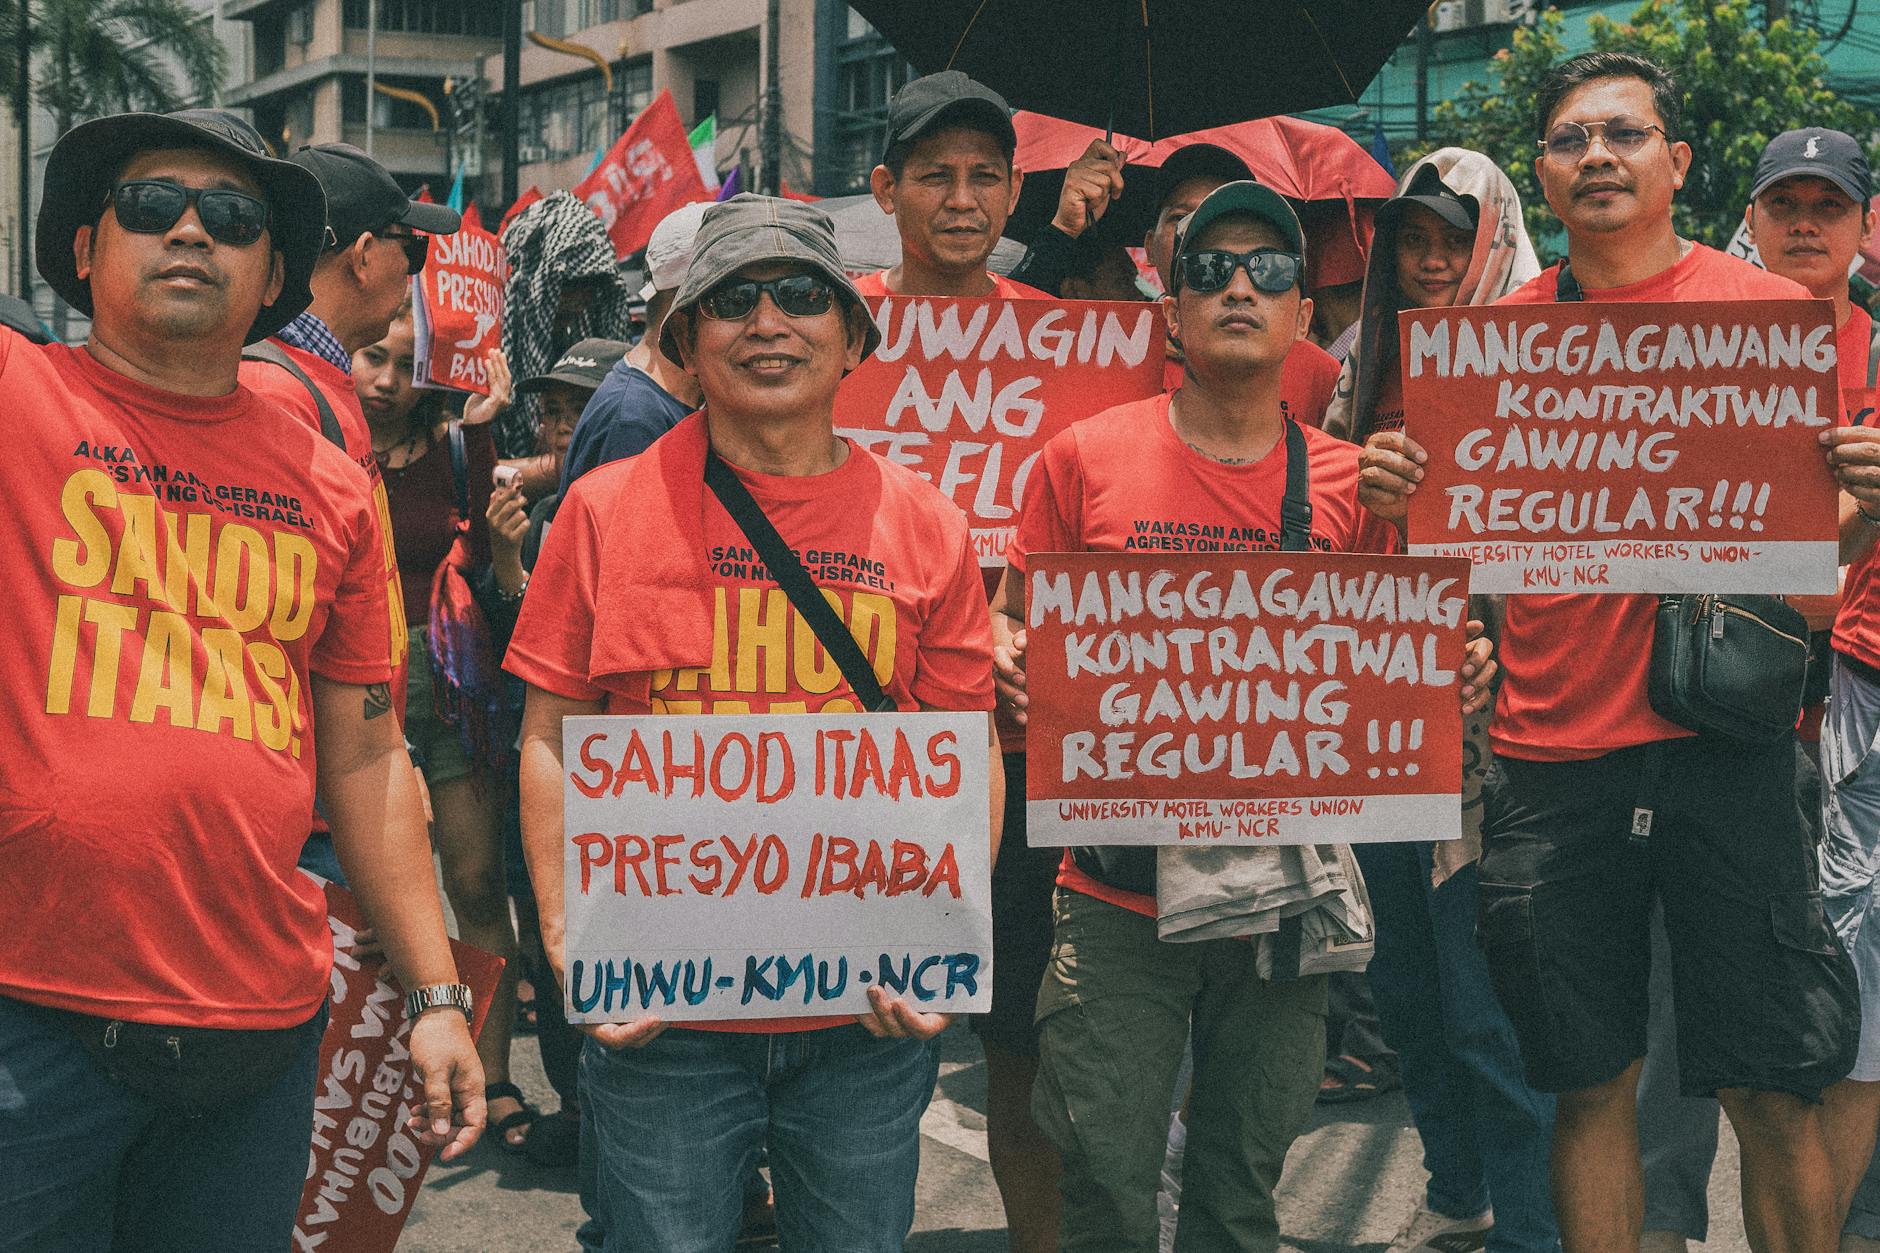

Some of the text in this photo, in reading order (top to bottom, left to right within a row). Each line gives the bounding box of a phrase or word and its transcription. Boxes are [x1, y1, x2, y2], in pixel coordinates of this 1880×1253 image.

[437, 269, 500, 319] PRESYO
[1409, 317, 1837, 378] MANGGAGAWANG
[885, 365, 1045, 437] ANG
[1495, 379, 1831, 427] KONTRAKTWAL
[1454, 424, 1680, 472] GAWING
[167, 485, 197, 502] NG
[215, 485, 302, 512] GERANG
[52, 468, 317, 641] SAHOD
[1125, 536, 1219, 551] AGRESYON
[1134, 520, 1224, 539] WAKASAN
[1228, 528, 1266, 542] ANG
[1543, 545, 1595, 562] HOTEL
[705, 546, 885, 576] SAN GERANG
[1523, 564, 1609, 587] KMU-NCR
[1030, 569, 1466, 630] MANGGAGAWANG
[650, 588, 896, 693] AHOD
[1064, 625, 1456, 687] KONTRAKTWAL
[1099, 679, 1351, 726] GAWING
[570, 727, 961, 804] SAHOD ITAAS
[1061, 730, 1351, 783] REGULAR
[1059, 799, 1364, 820] UNIVERSITY HOTEL WORKERS UNION
[572, 832, 964, 900] PRESYO IBABA
